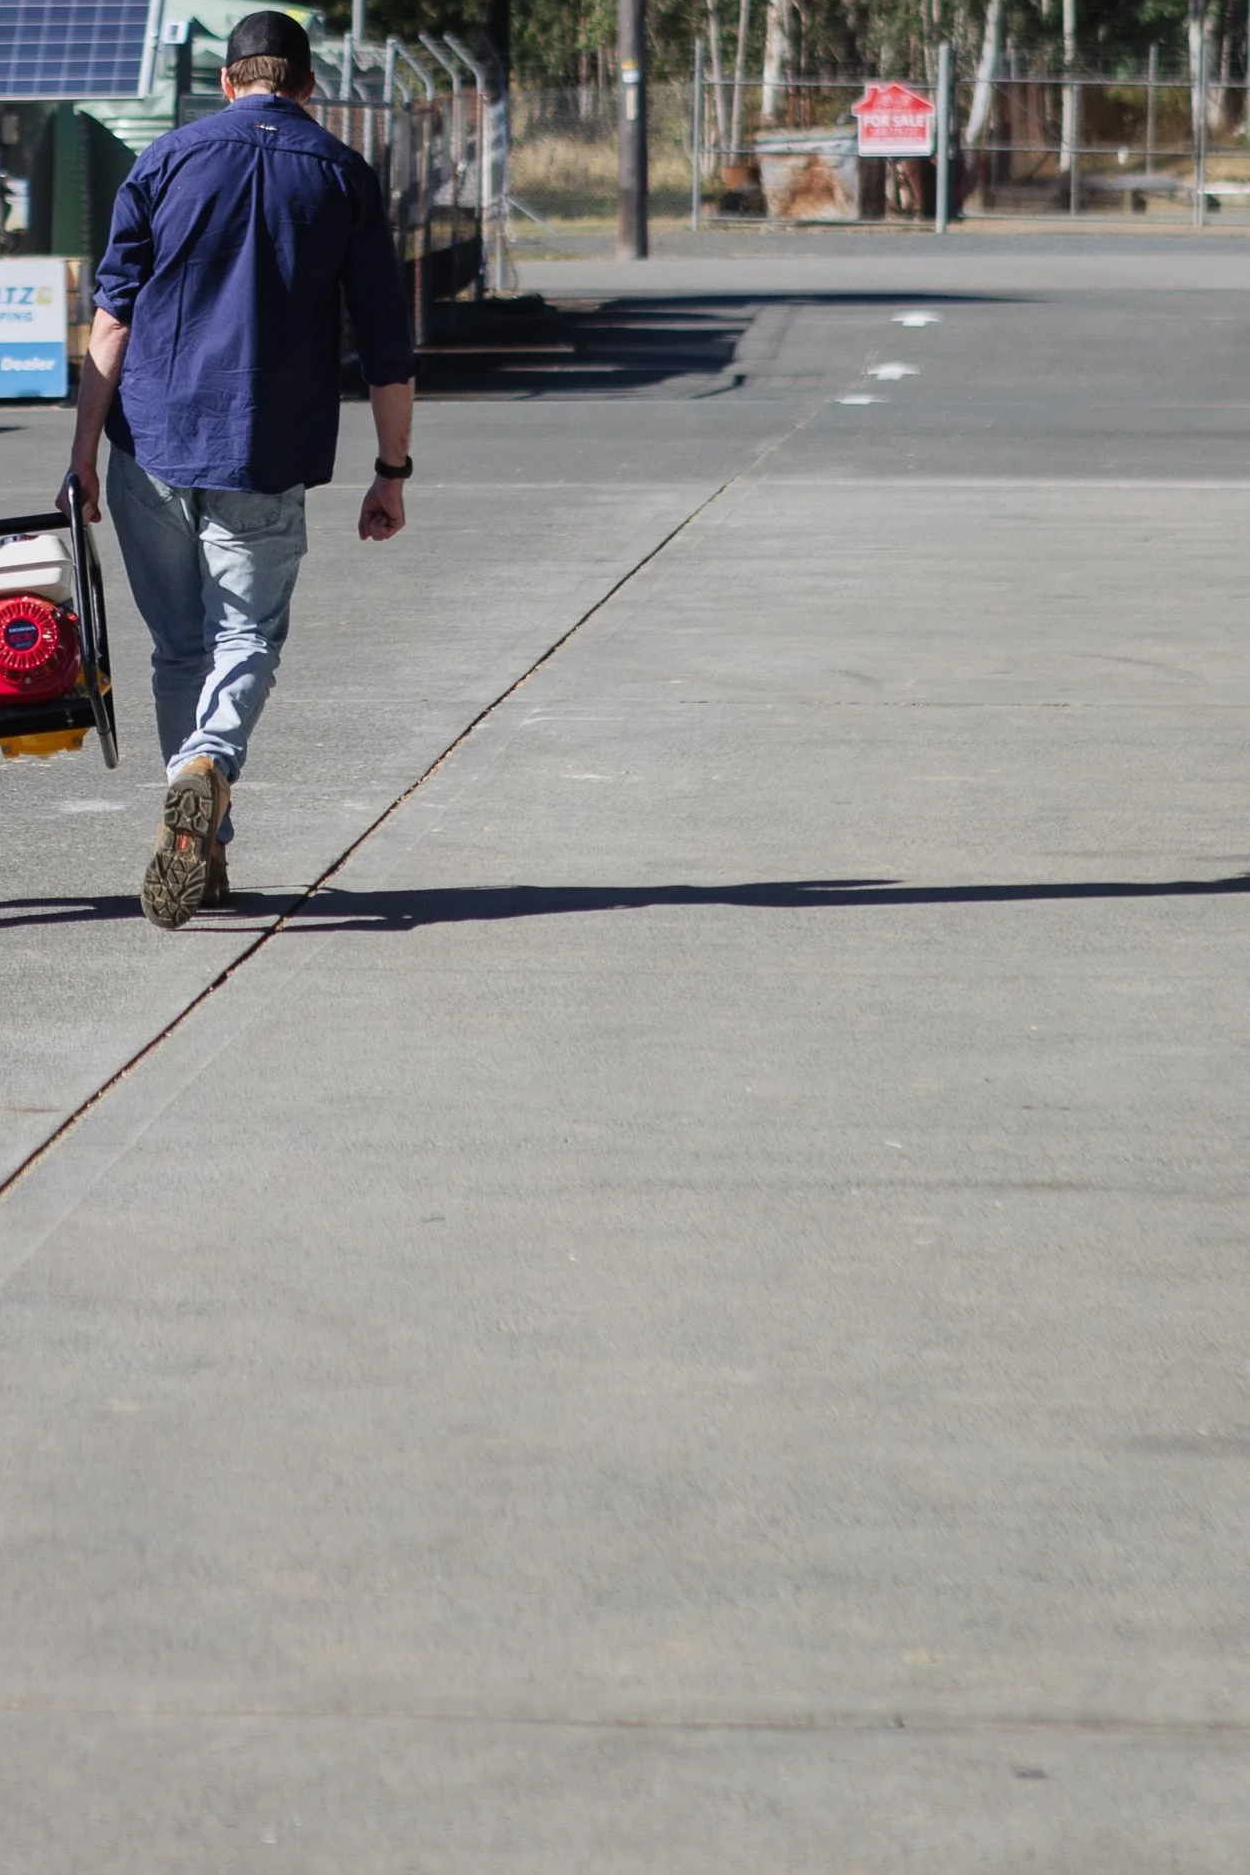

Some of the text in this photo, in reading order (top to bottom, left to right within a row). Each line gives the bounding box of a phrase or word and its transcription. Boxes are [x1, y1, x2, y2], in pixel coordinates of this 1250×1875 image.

[863, 114, 925, 127] FOR SALE
[1, 356, 56, 371] Dealer
[8, 625, 37, 633] HONDA
